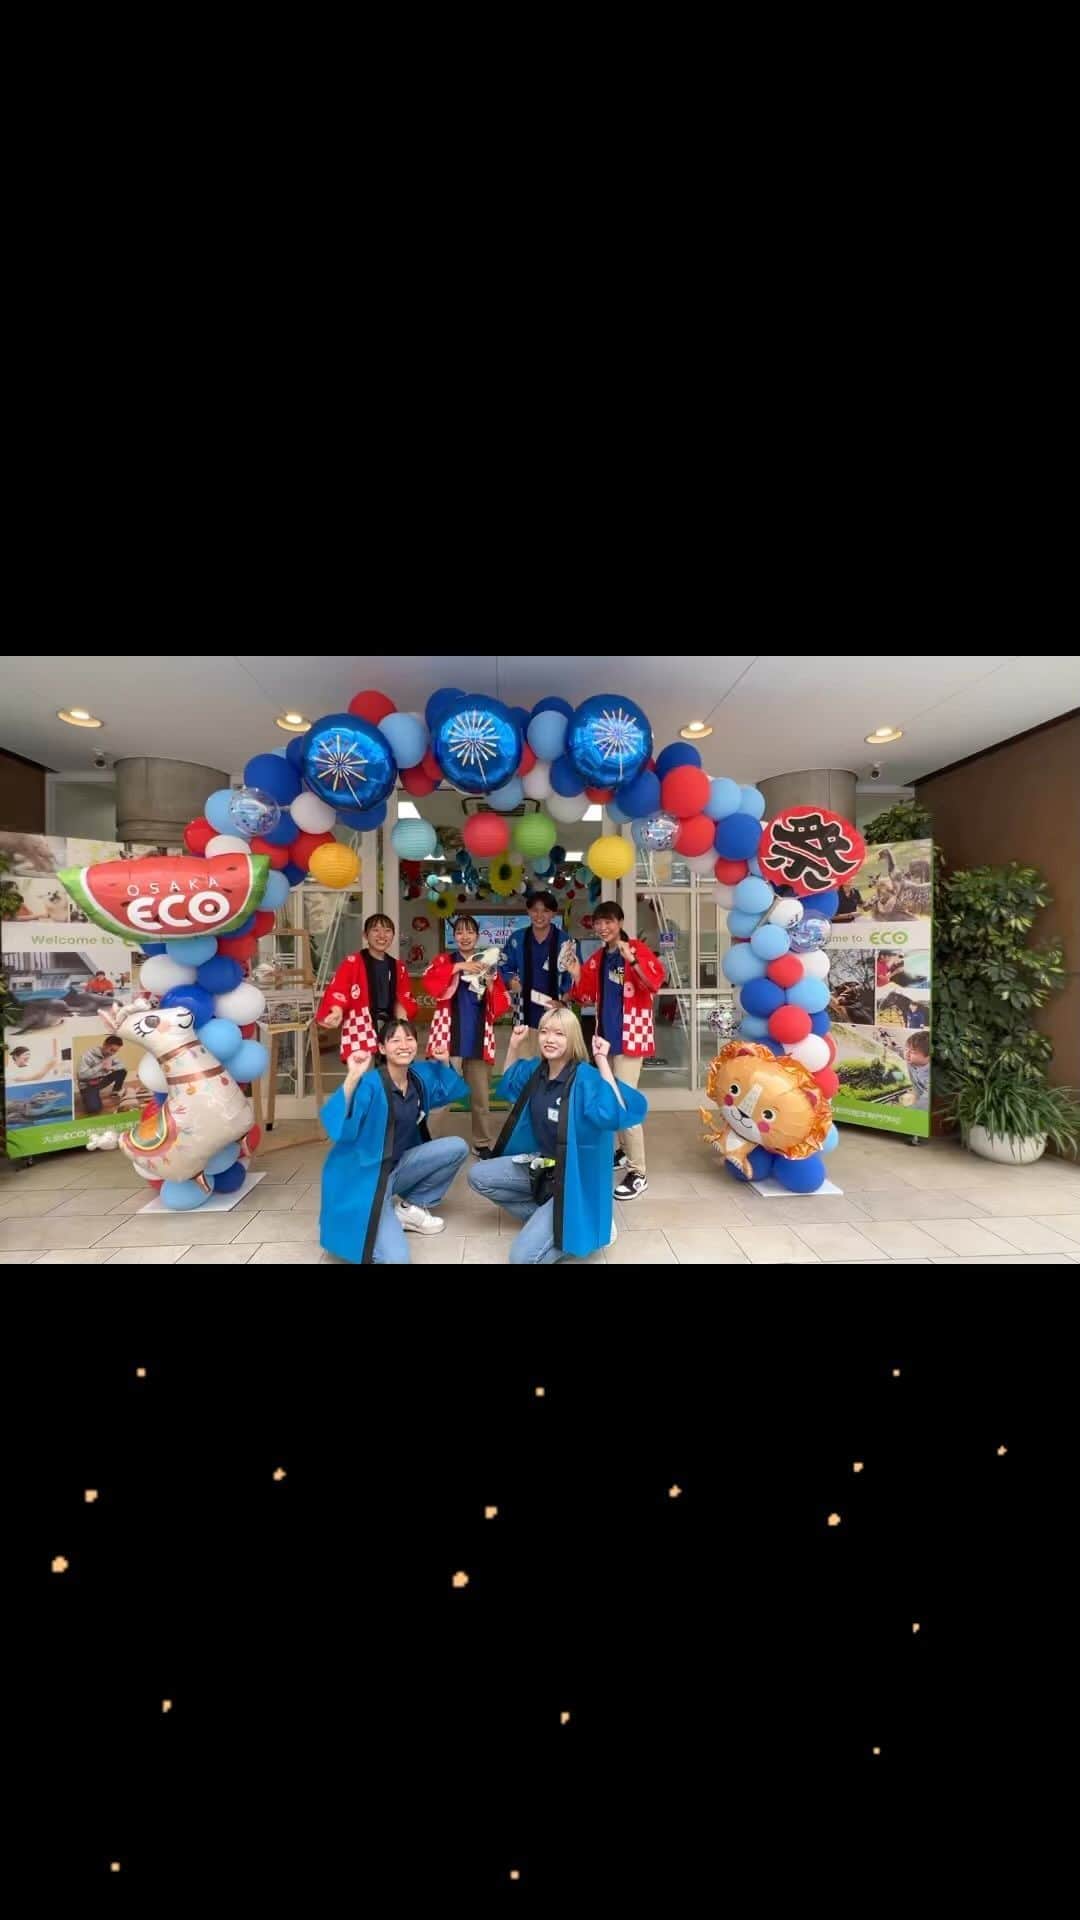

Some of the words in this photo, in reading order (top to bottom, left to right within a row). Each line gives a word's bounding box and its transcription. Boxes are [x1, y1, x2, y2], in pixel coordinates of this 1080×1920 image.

[761, 813, 861, 891] 祭
[127, 876, 219, 896] OSAKA
[127, 890, 230, 930] ECO
[31, 935, 97, 945] Welcome
[869, 931, 908, 945] ECO
